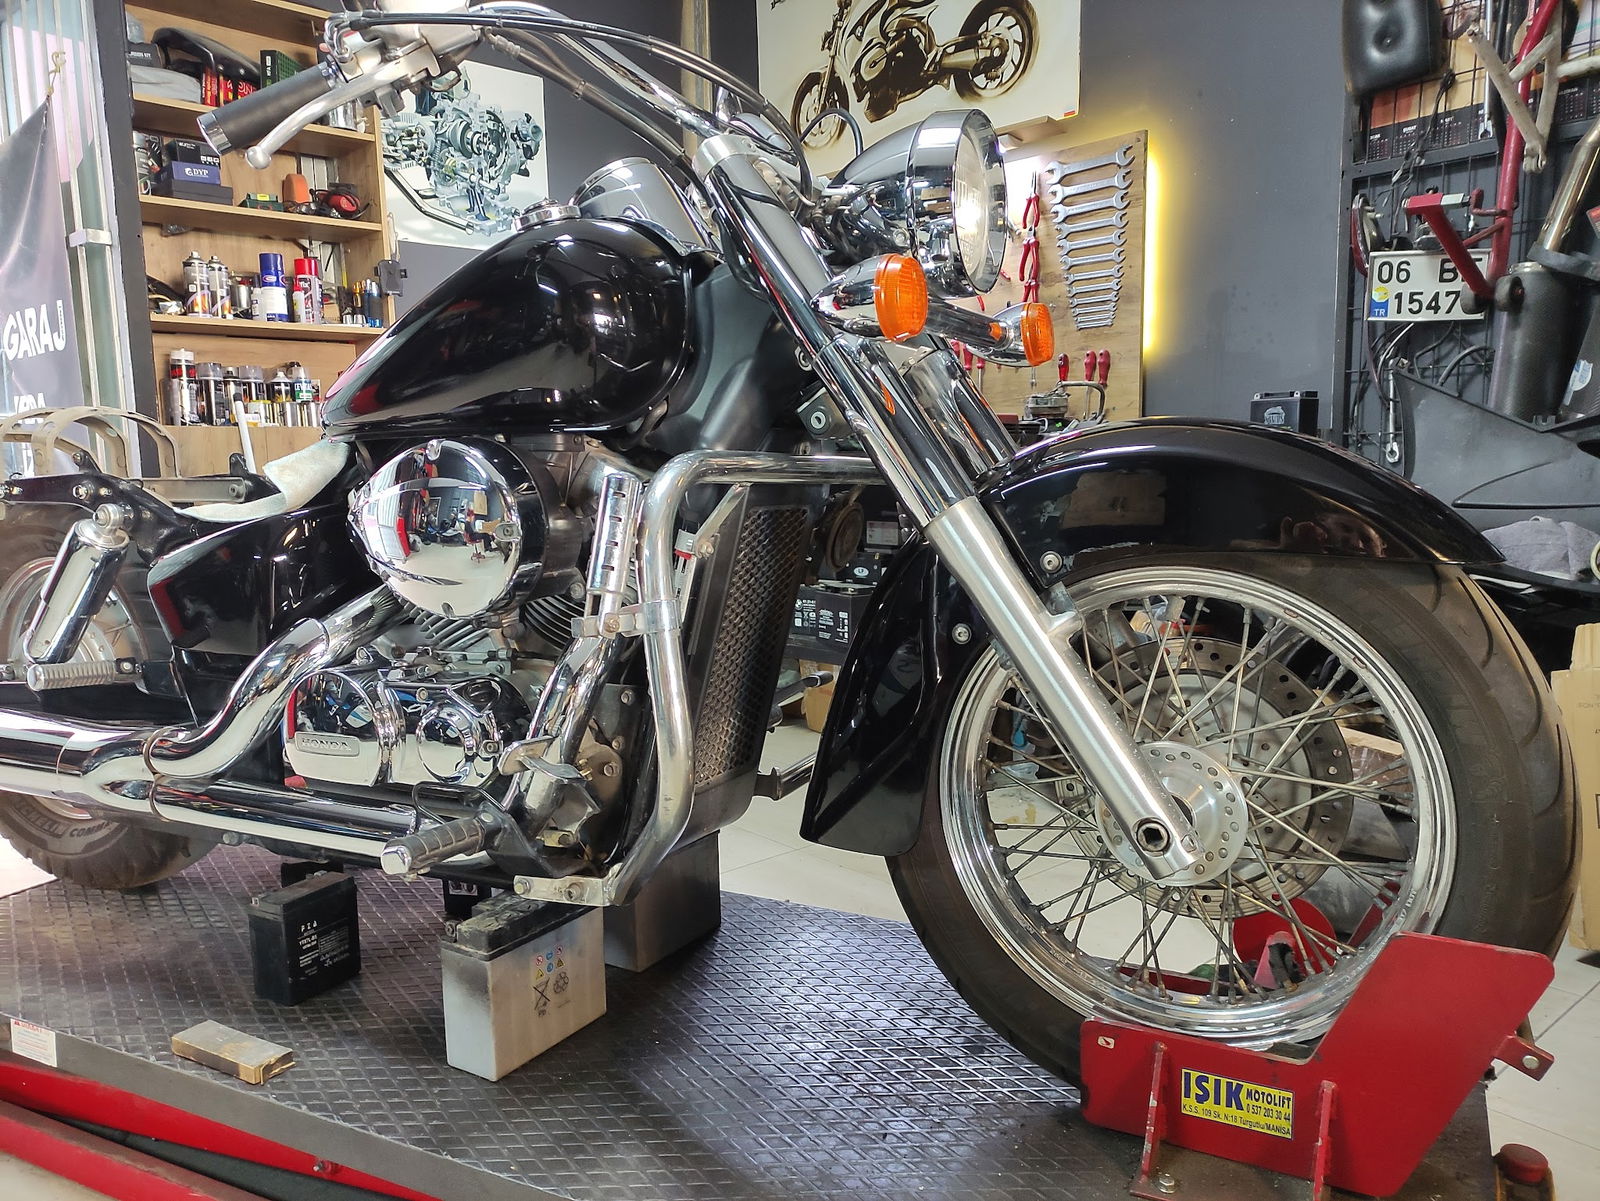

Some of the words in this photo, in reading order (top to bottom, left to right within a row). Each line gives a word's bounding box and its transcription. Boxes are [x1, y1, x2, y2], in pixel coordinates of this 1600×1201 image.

[1377, 260, 1411, 284] 06
[1374, 308, 1386, 317] TR
[1394, 290, 1461, 315] 1547
[2, 299, 67, 361] GARAJ
[301, 737, 352, 751] HONDA
